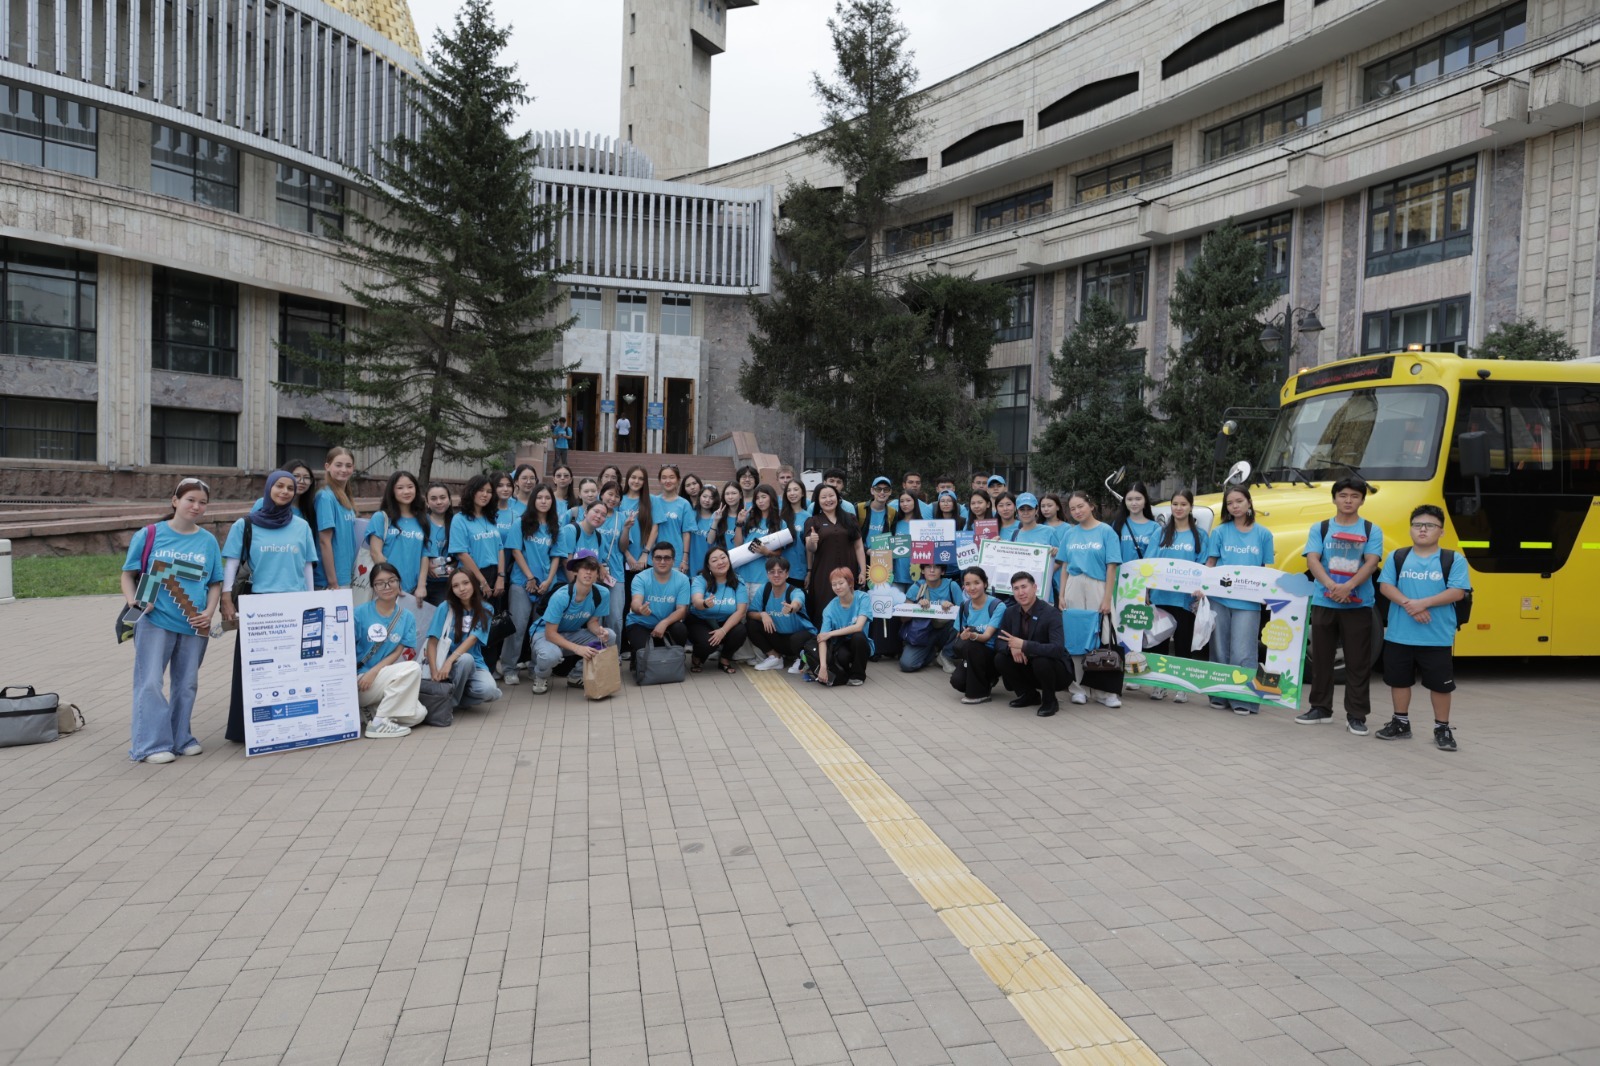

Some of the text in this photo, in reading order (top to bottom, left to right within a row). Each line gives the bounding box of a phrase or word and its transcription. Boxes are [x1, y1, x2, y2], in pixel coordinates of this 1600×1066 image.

[388, 528, 414, 538] uncef
[473, 530, 492, 541] unicef
[260, 543, 290, 552] unicef
[1225, 544, 1250, 554] unicef
[155, 549, 194, 561] unicef
[956, 548, 976, 559] VOTE
[1166, 567, 1192, 576] unicef
